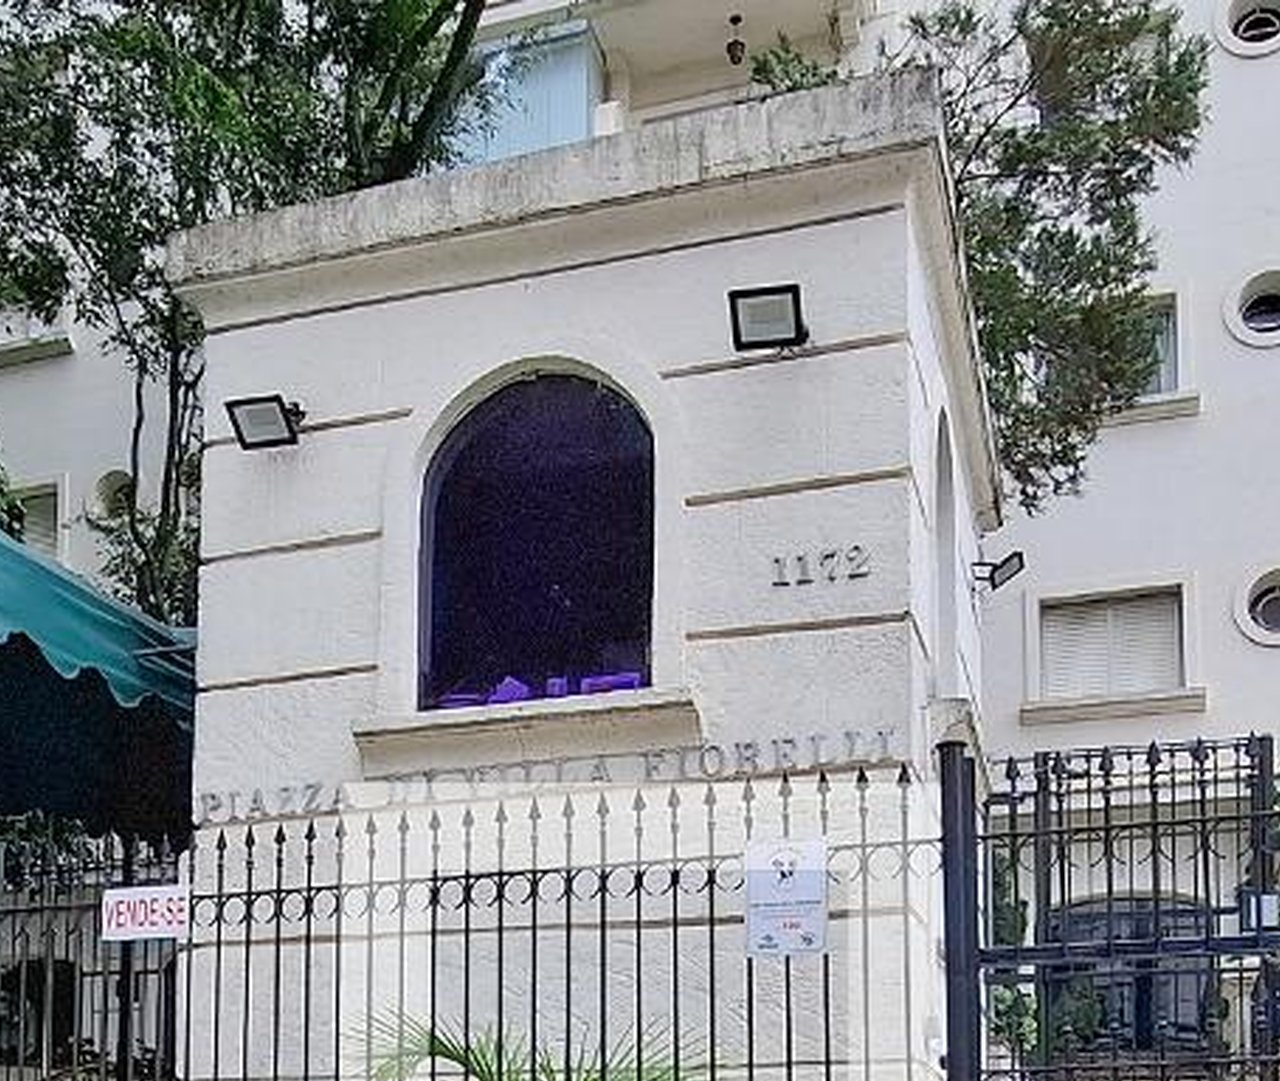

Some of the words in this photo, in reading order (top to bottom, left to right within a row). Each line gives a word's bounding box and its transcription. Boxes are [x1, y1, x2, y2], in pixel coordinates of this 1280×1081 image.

[772, 545, 871, 586] 1172
[199, 782, 352, 823] PIAZZA
[104, 896, 187, 929] VENDE-SE
